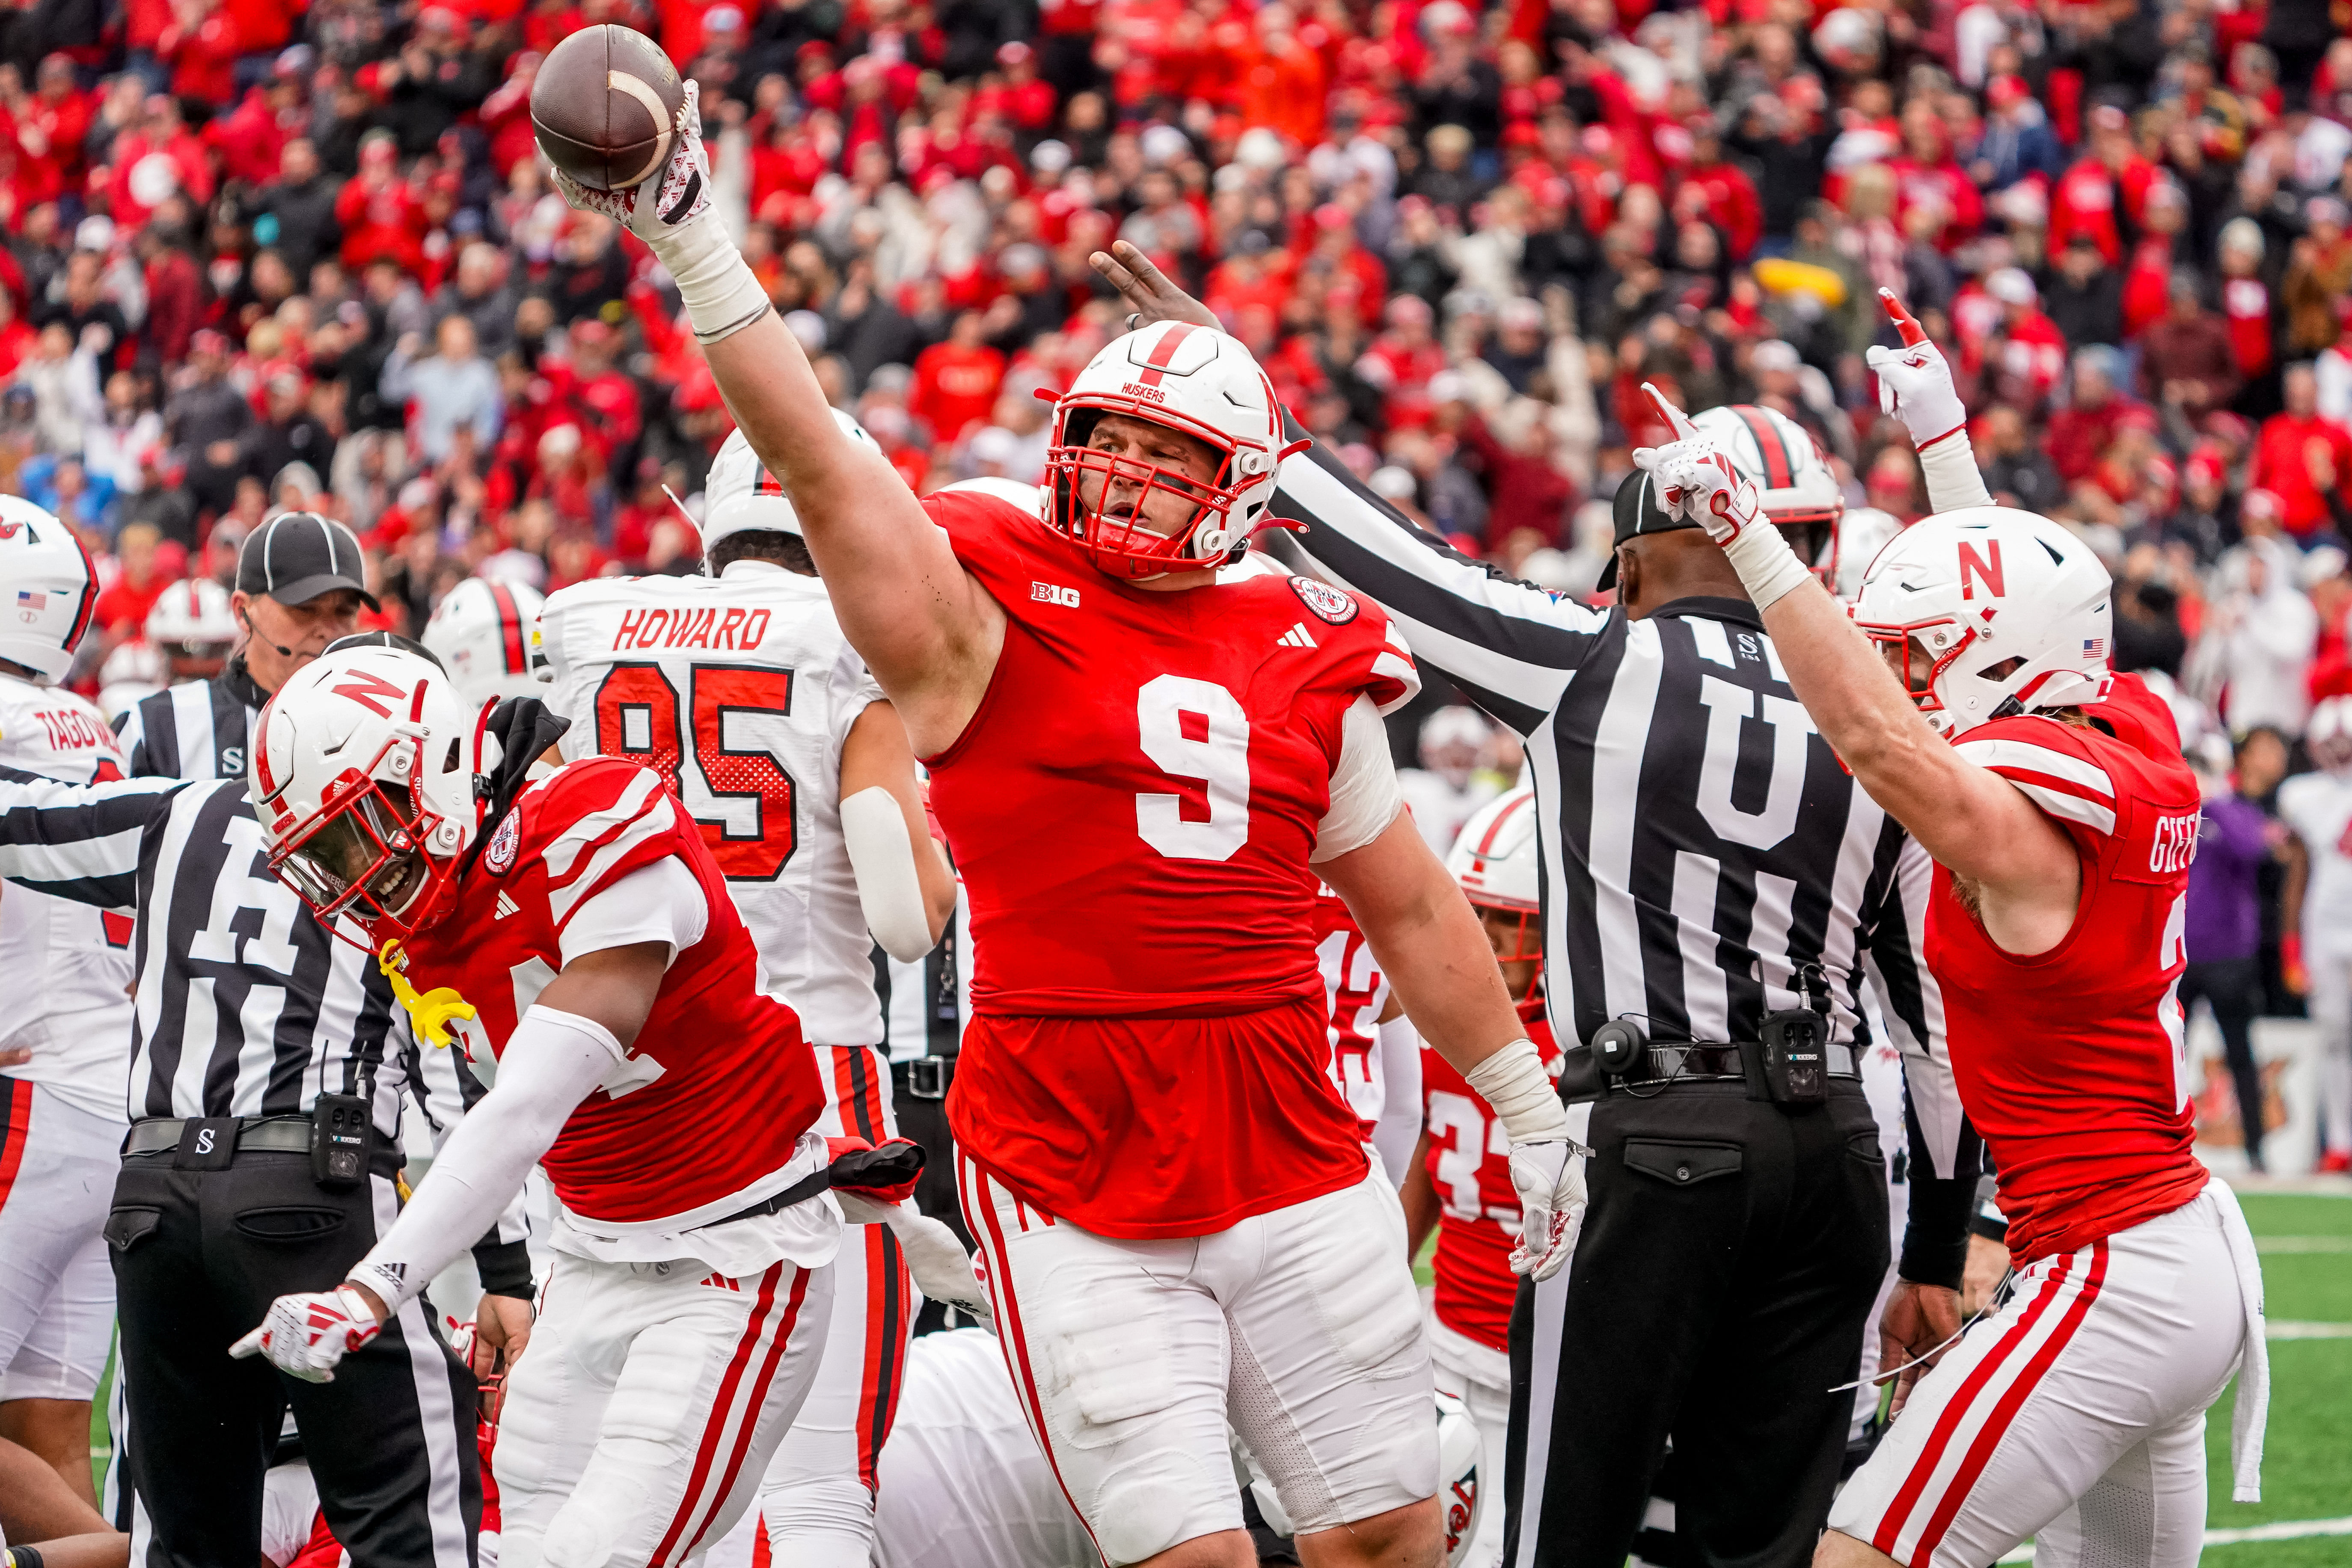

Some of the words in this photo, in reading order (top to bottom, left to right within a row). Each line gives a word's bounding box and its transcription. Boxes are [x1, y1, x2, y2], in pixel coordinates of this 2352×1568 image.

[1122, 382, 1165, 403] HUSKERS
[1305, 587, 1343, 601] HUSKERS
[1958, 540, 2005, 600] N
[613, 608, 772, 651] HOWARD
[1303, 595, 1327, 619] WINNING
[1331, 603, 1355, 621] TRADITION
[331, 669, 407, 720] N
[1136, 673, 1250, 861] 9
[1696, 674, 1818, 851] U
[188, 816, 301, 976] H
